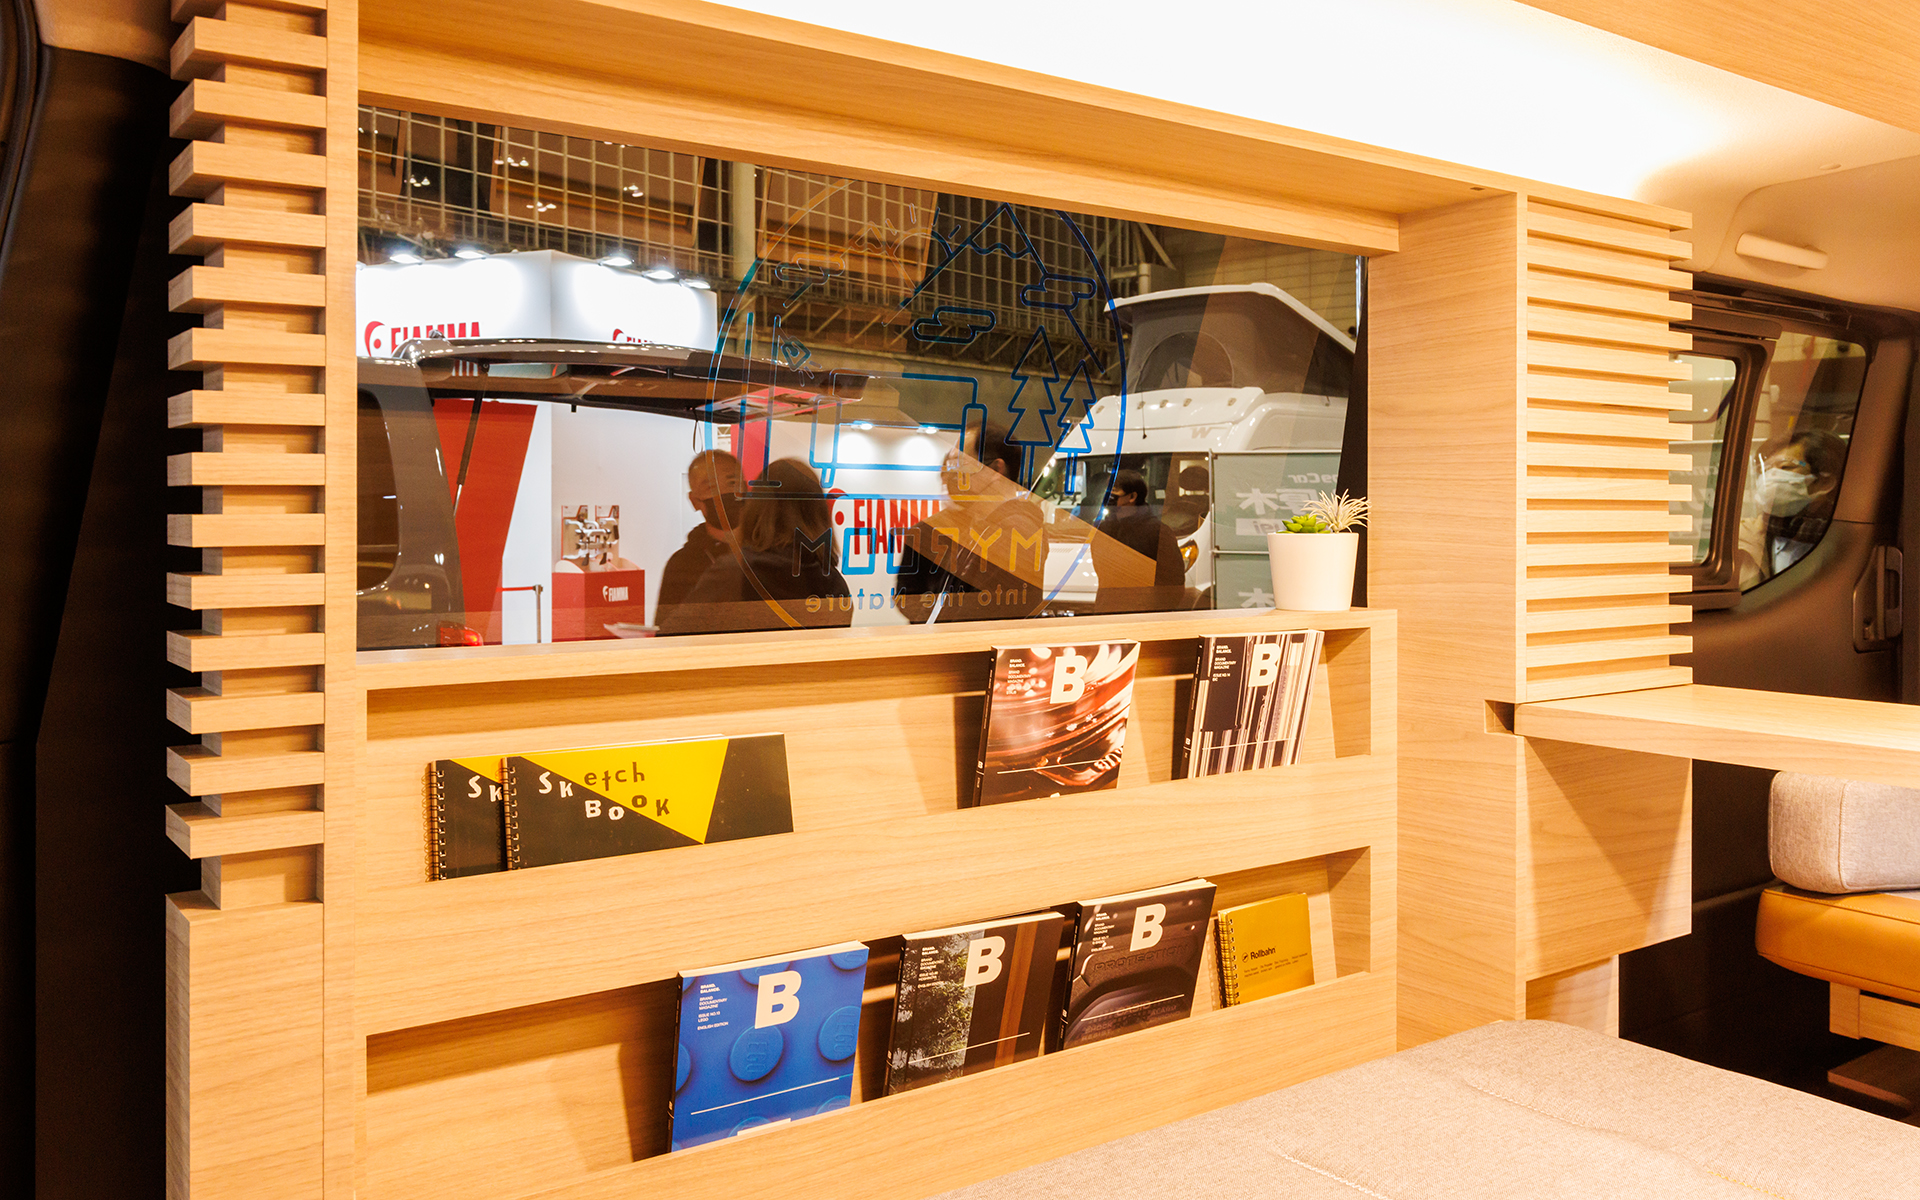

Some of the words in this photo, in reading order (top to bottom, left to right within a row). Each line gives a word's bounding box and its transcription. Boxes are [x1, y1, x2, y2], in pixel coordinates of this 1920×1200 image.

[1050, 655, 1088, 705] B
[1248, 643, 1281, 688] B
[1129, 903, 1167, 952] B
[964, 935, 1006, 988] B
[1093, 944, 1189, 974] PROTECTION
[1250, 947, 1276, 960] Rollbahn
[754, 970, 802, 1029] B
